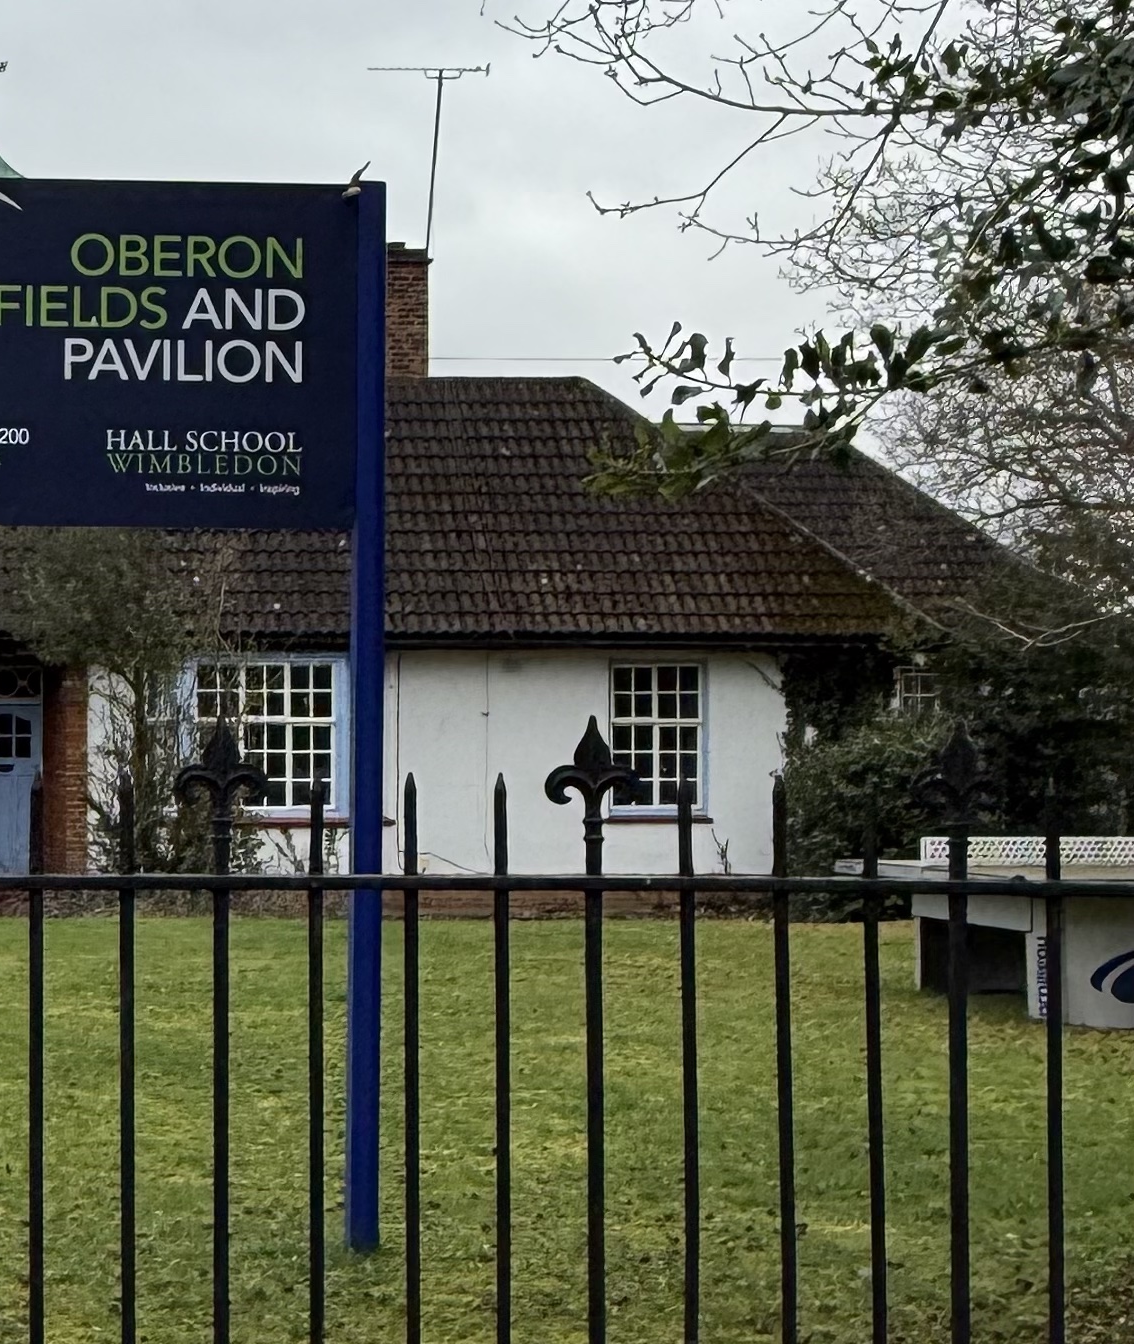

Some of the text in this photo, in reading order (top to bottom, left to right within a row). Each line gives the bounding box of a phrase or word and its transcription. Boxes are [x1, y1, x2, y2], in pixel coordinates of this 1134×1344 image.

[70, 233, 304, 279] OBERON
[182, 288, 306, 330] AND
[63, 338, 304, 384] PAVILION
[106, 429, 303, 453] HALL SCHOOL
[107, 453, 303, 476] WIMBLEDON
